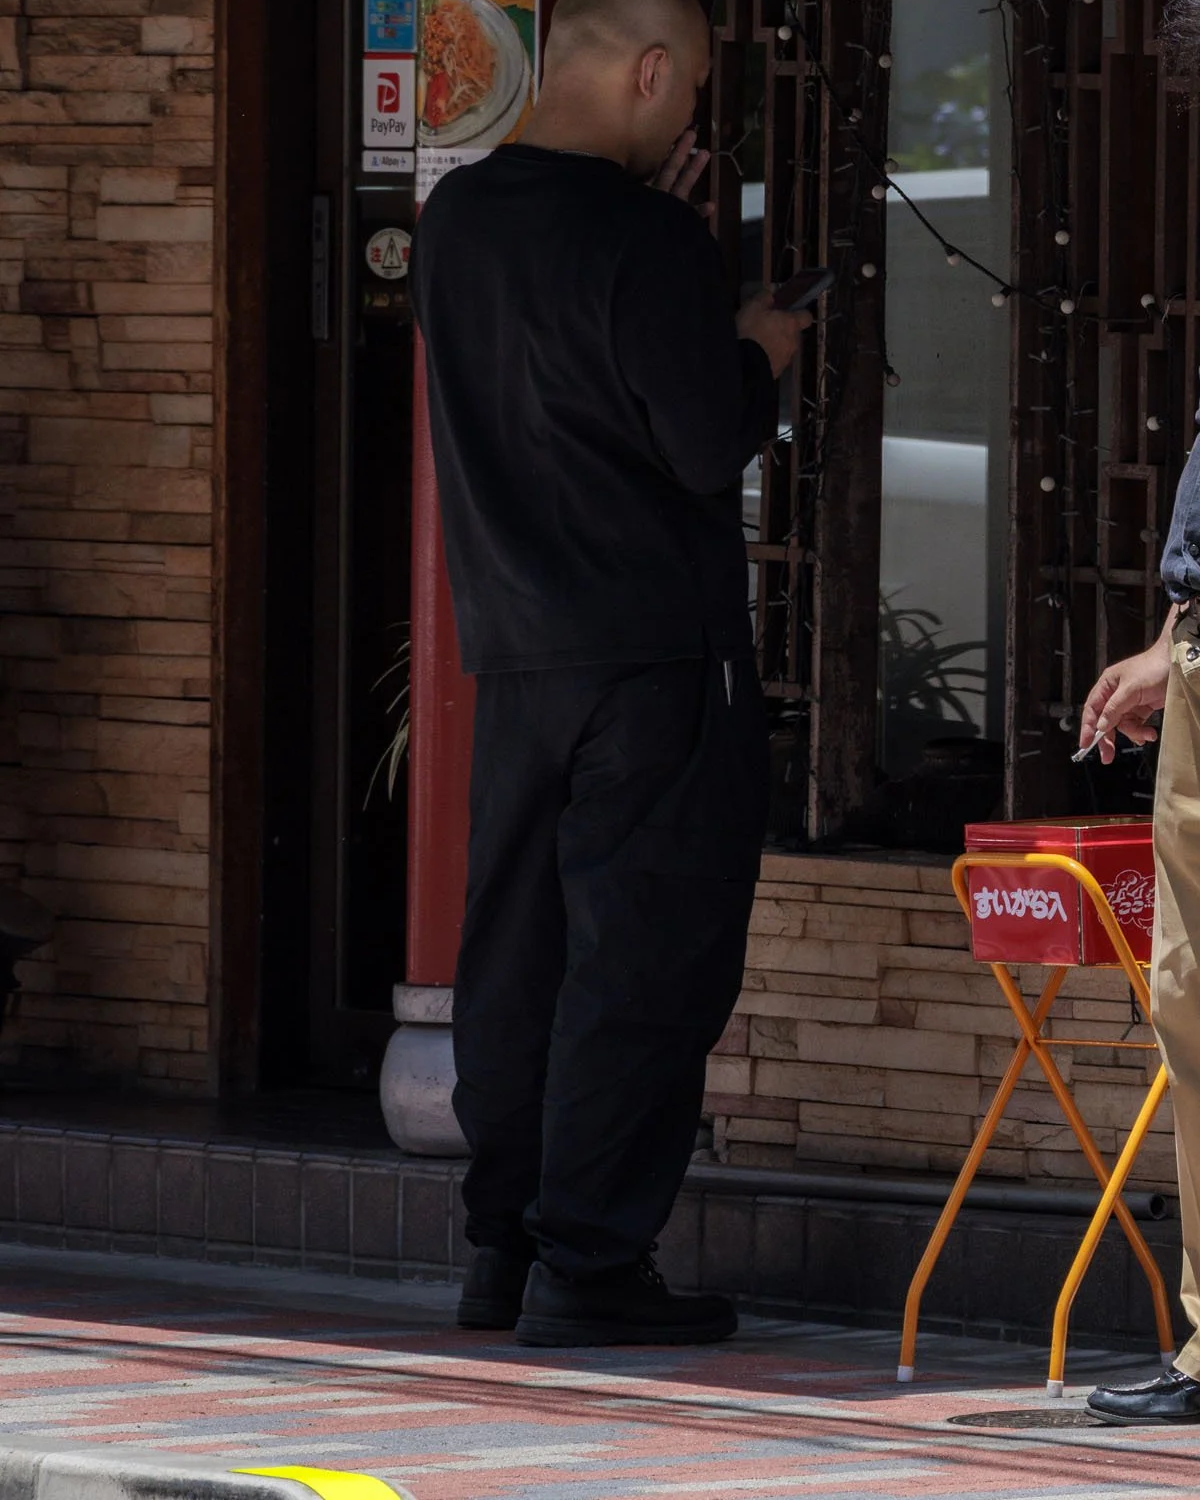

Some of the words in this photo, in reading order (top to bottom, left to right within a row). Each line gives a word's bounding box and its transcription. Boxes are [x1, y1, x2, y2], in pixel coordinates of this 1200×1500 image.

[371, 118, 407, 137] PayPay
[973, 885, 1069, 924] すいがら入
